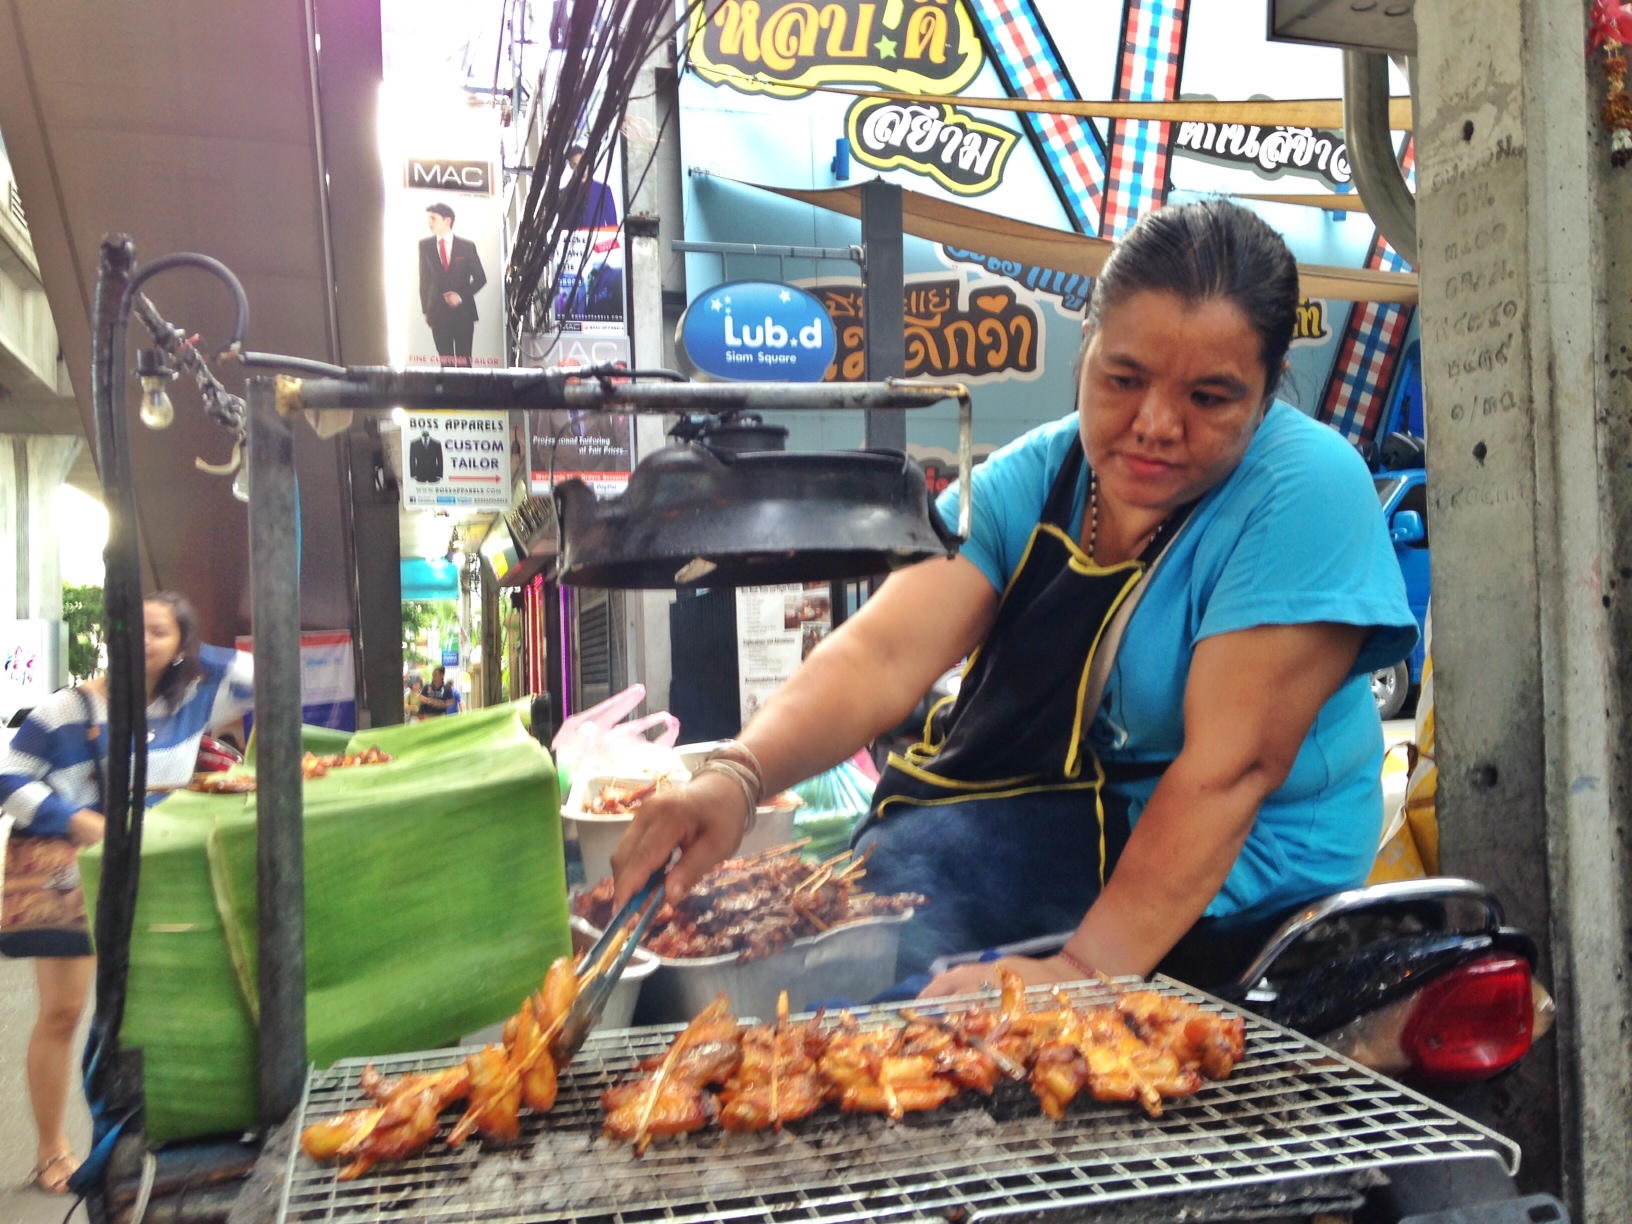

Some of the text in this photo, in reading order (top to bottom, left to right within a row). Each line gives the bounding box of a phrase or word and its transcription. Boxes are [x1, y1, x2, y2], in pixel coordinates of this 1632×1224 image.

[413, 162, 484, 187] MAC
[409, 354, 427, 362] FINE
[726, 351, 797, 365] Siam Square
[409, 417, 504, 431] BOSS APPARELS
[444, 439, 504, 452] CUSTOM
[450, 457, 499, 469] TAILOR
